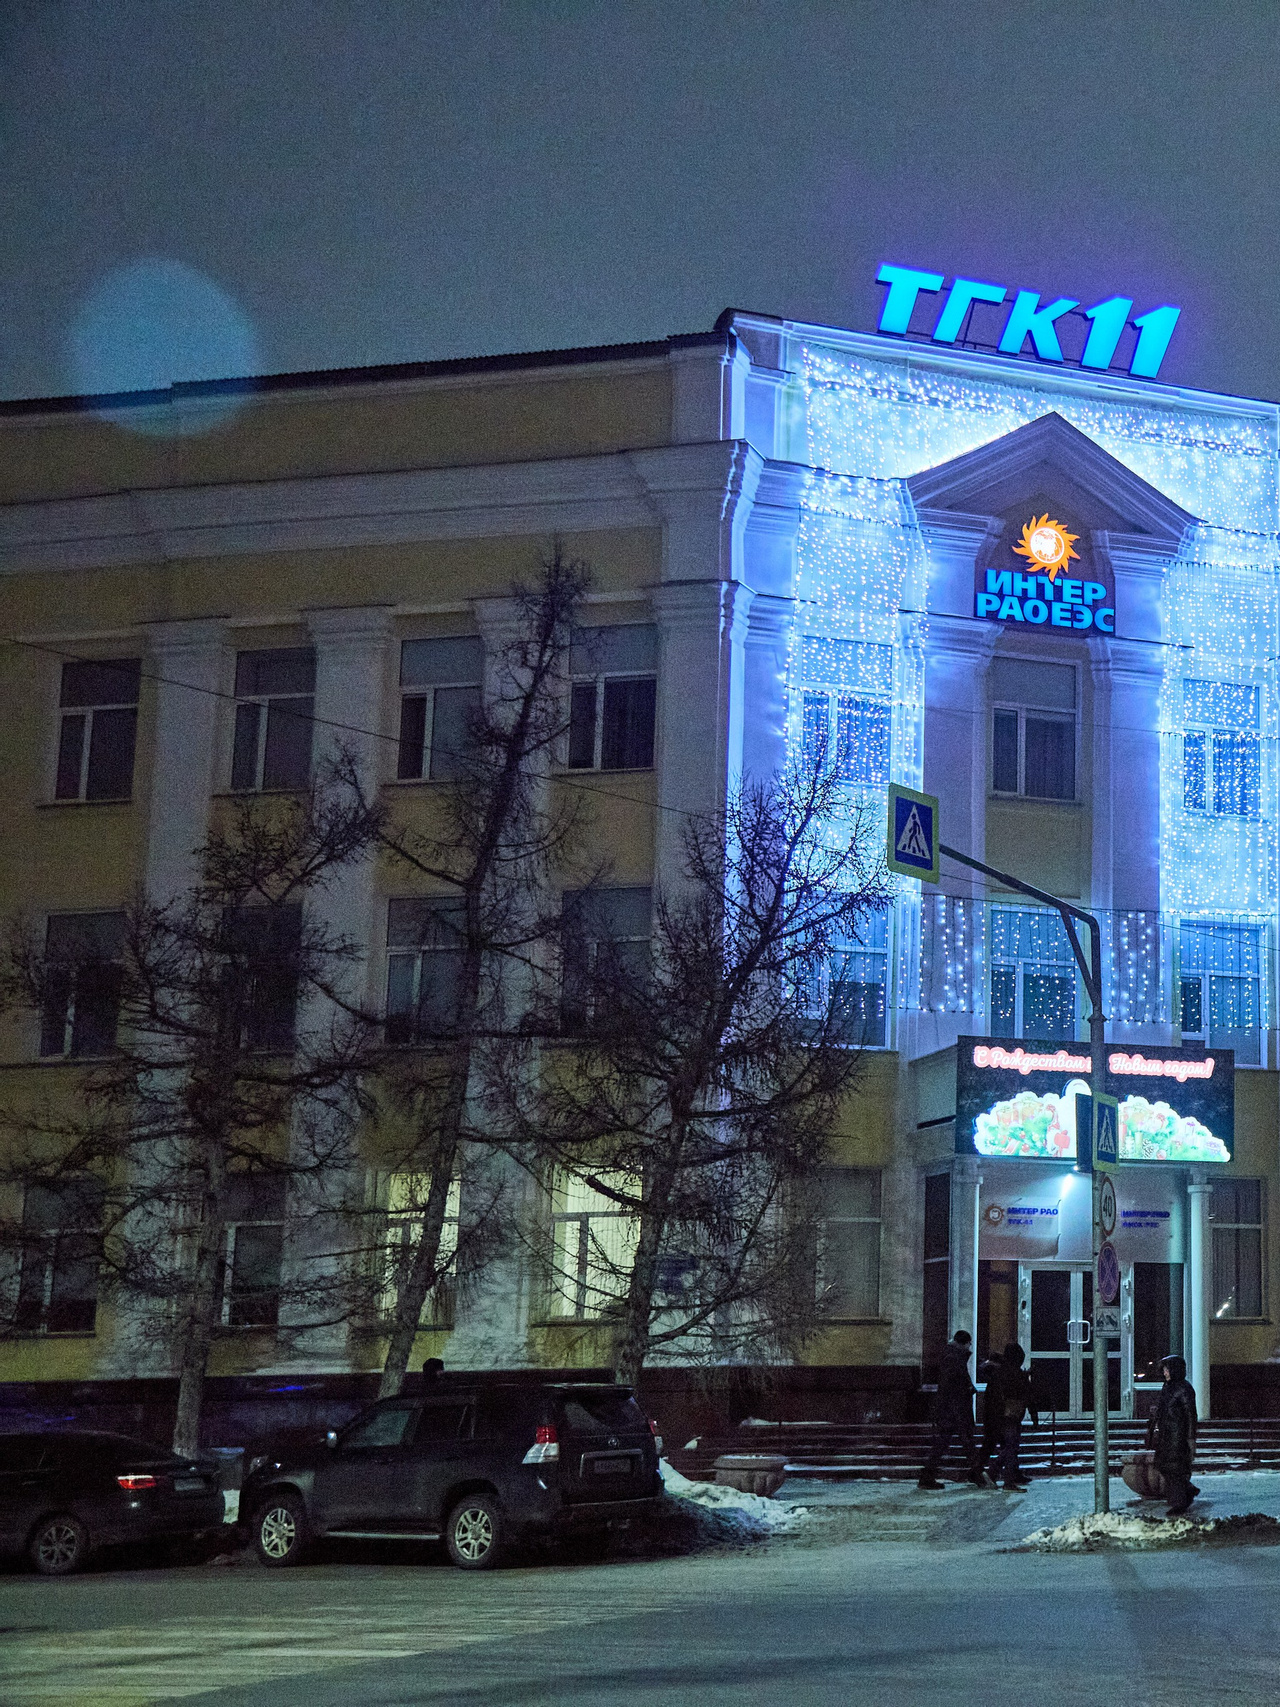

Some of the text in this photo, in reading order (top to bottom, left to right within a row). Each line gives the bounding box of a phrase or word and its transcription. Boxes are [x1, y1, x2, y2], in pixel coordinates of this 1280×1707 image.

[875, 262, 1181, 379] ТГК11
[985, 568, 1107, 606] ИНТЕР
[975, 1048, 988, 1065] С
[990, 1049, 1085, 1074] Рождеством
[1110, 1055, 1163, 1073] Новым
[1164, 1060, 1213, 1080] годом!
[1040, 1207, 1059, 1216] РАО
[1103, 1195, 1113, 1218] 40
